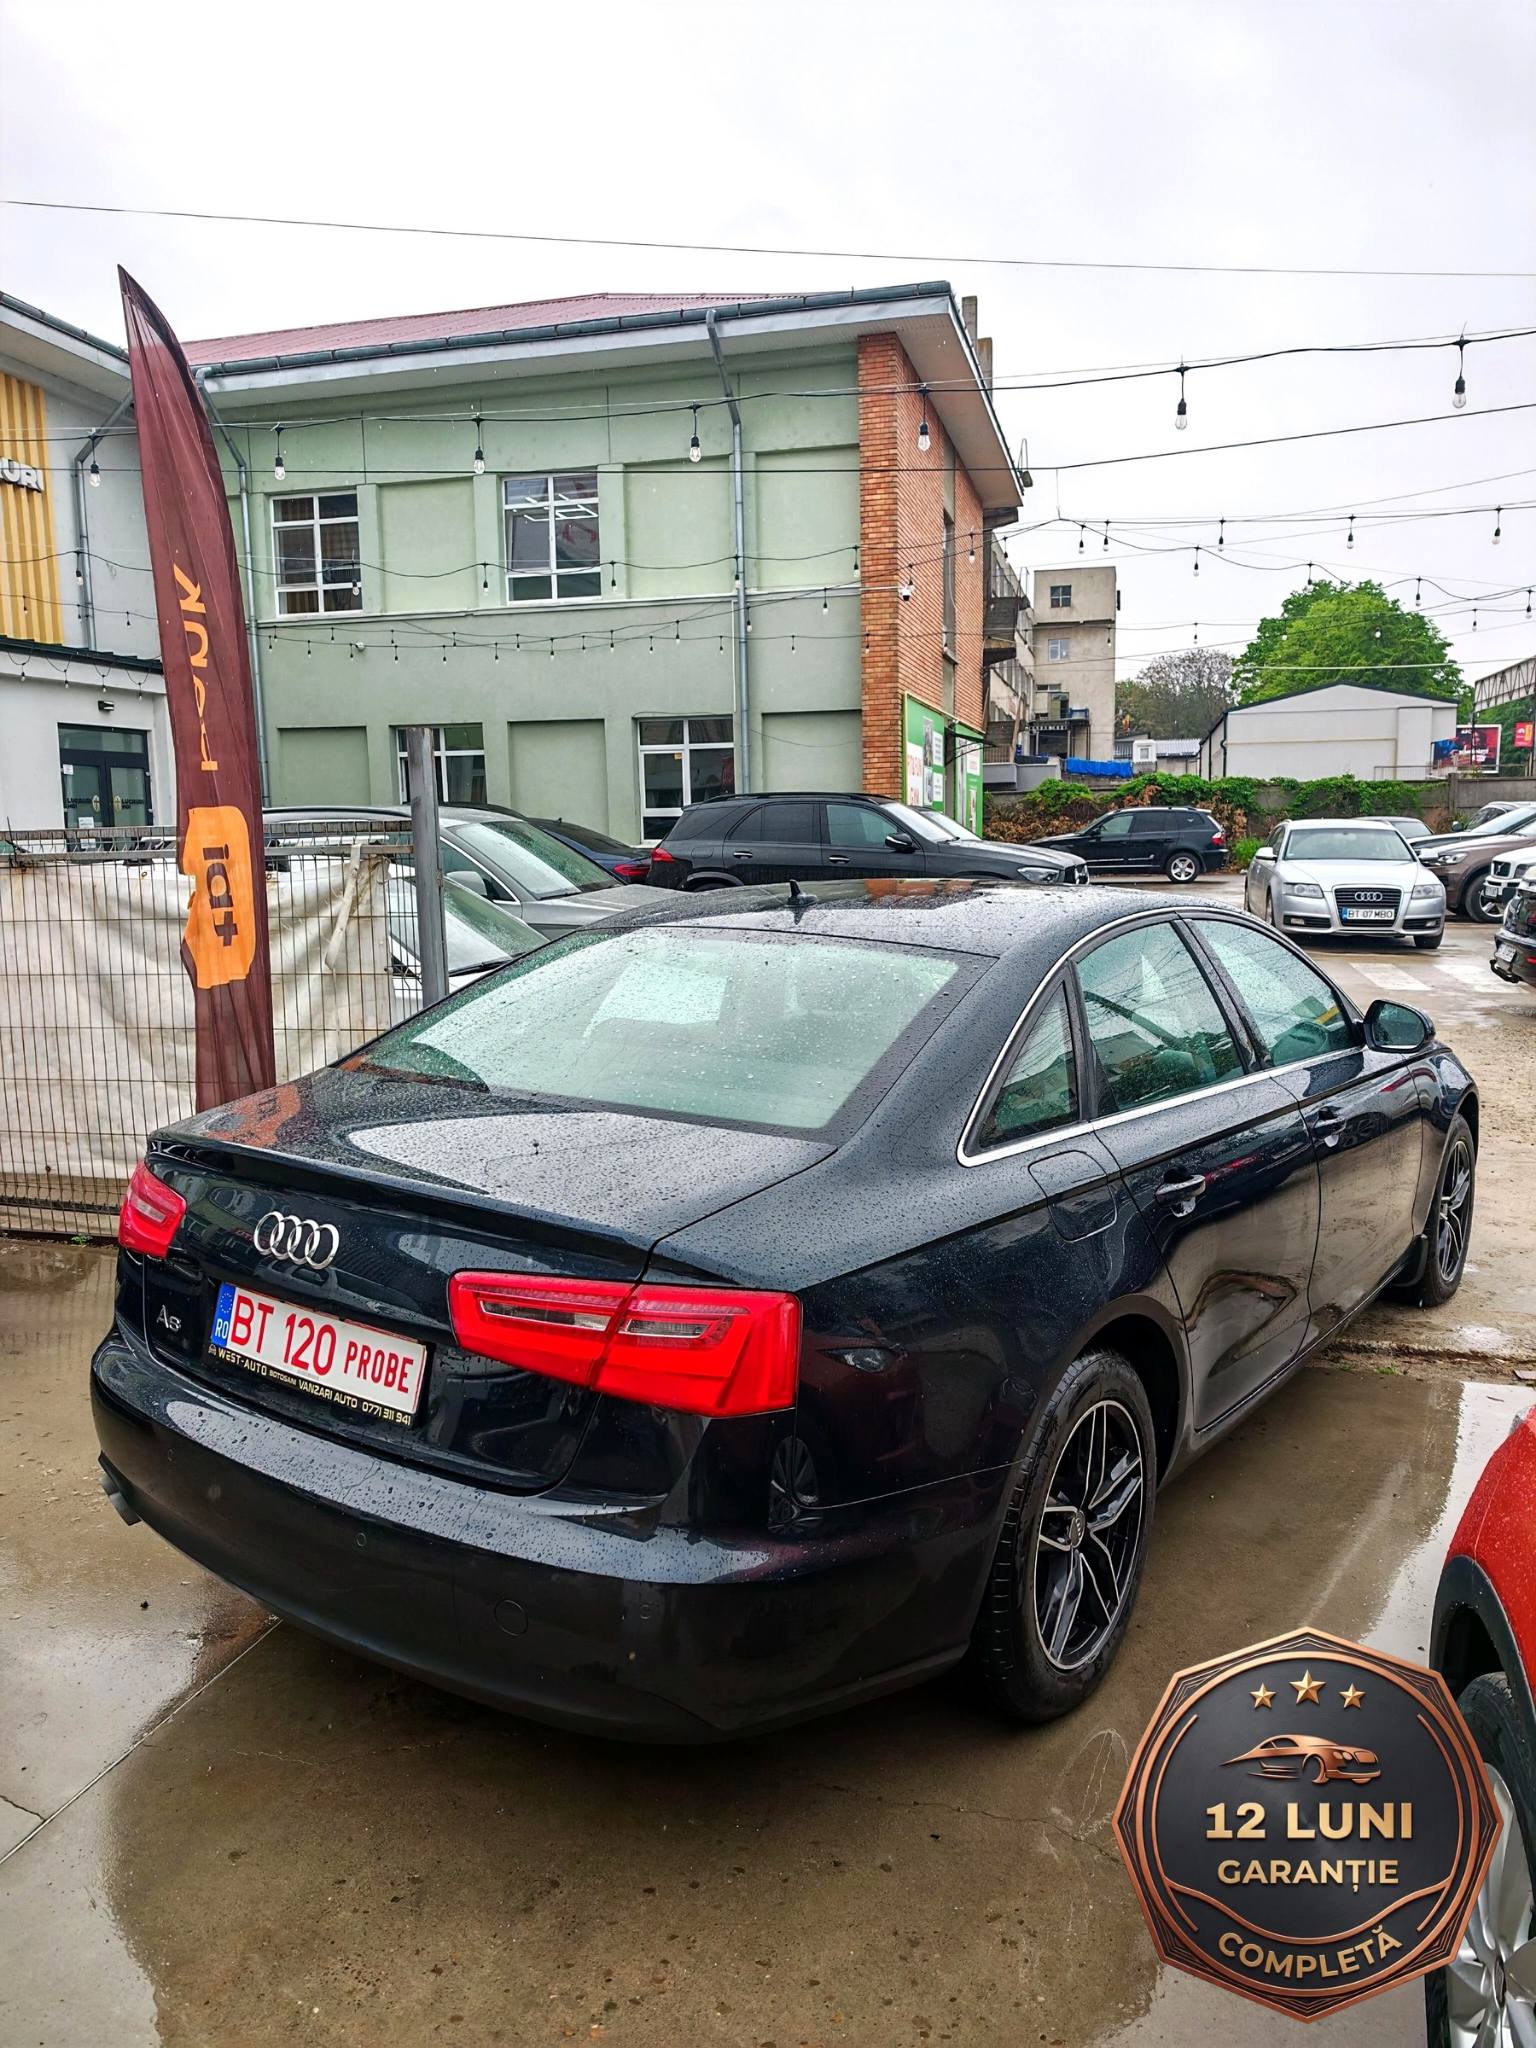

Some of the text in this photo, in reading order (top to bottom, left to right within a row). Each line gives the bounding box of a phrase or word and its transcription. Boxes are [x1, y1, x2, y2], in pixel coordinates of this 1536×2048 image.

[157, 1304, 182, 1332] A6
[214, 1318, 229, 1340] RO
[230, 1295, 414, 1394] BT 120 PROBE
[218, 1347, 268, 1376] WEST-AUTO
[298, 1379, 333, 1400] VANZARI
[333, 1392, 358, 1409] AUTO
[362, 1401, 382, 1417] 0771
[383, 1408, 394, 1420] 311
[395, 1413, 411, 1426] 941
